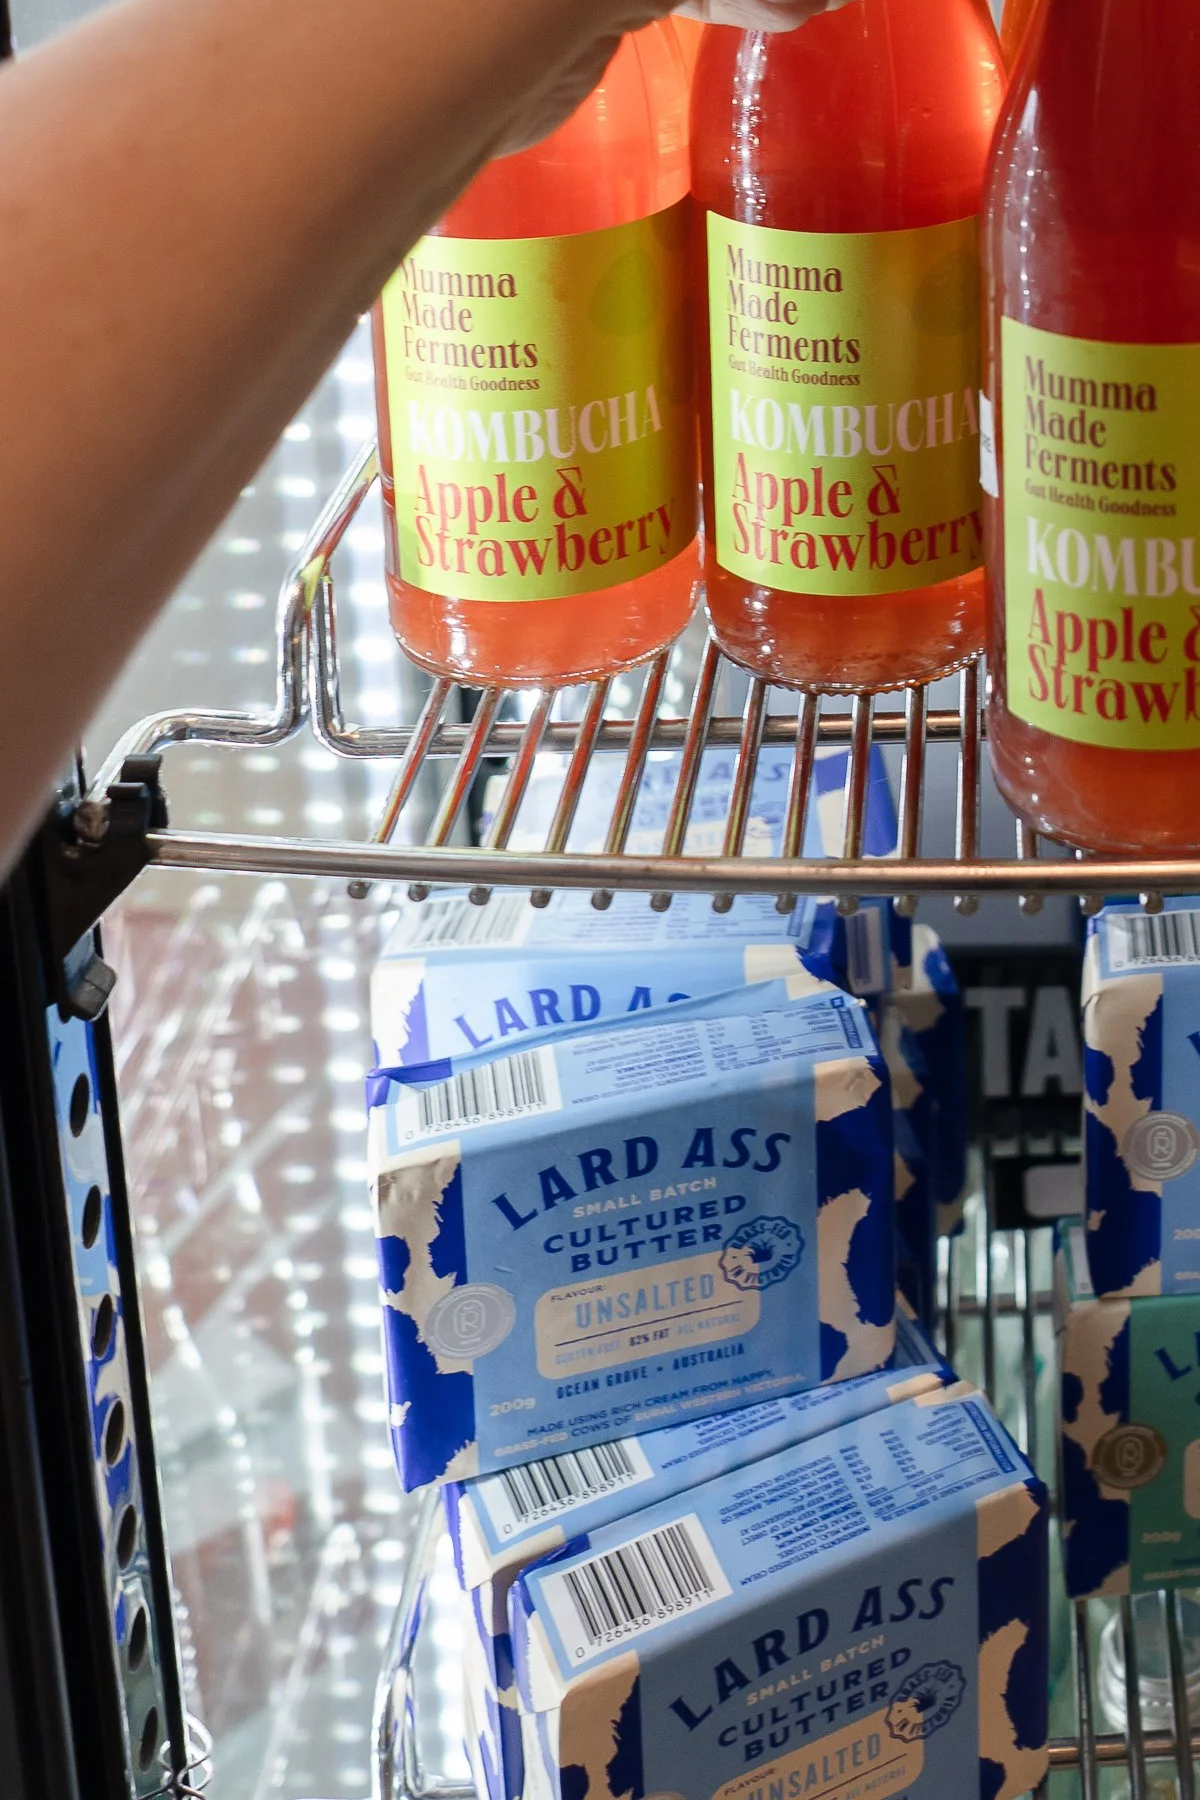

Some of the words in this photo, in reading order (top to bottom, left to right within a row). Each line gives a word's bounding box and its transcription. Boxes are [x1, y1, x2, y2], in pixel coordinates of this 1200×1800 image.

[402, 257, 518, 298] Mumma
[727, 244, 844, 293] Mumma
[402, 290, 473, 333] Made
[727, 279, 798, 326] Made
[404, 325, 538, 369] Ferments
[728, 314, 861, 364] Ferments
[1024, 354, 1158, 413] Mumma
[409, 384, 665, 464] KOMBUCHA
[730, 386, 983, 459] KOMBUCHA
[1023, 395, 1107, 448] Made
[733, 452, 853, 527] Apple
[867, 463, 900, 517] &
[1025, 433, 1177, 493] Ferments
[415, 464, 539, 536] Apple
[553, 466, 588, 520] &
[415, 503, 674, 578] Strawberry
[733, 502, 984, 571] Strawberry
[1028, 587, 1168, 673] Apple
[453, 984, 602, 1049] LARD
[490, 1135, 658, 1232] LARD
[681, 1126, 792, 1174] ASS
[573, 1193, 642, 1220] SMALL
[649, 1176, 718, 1202] BATCH
[542, 1194, 748, 1254] CULTURED
[571, 1223, 723, 1274] BUTTER
[575, 1273, 715, 1329] UNSALTED
[556, 1378, 600, 1400] OCEAN
[605, 1365, 648, 1388] GROVE
[672, 1343, 746, 1371] AUSTRALIA
[489, 1397, 536, 1418] 200g
[575, 1647, 586, 1658] 0
[595, 1617, 651, 1647] 726436
[658, 1589, 713, 1619] 898911
[668, 1608, 829, 1733] LARD
[850, 1576, 955, 1633] ASS
[747, 1670, 812, 1706] SMALL
[820, 1634, 885, 1673] BATCH
[717, 1647, 912, 1747] CULTURED
[744, 1680, 890, 1762] BUTTER
